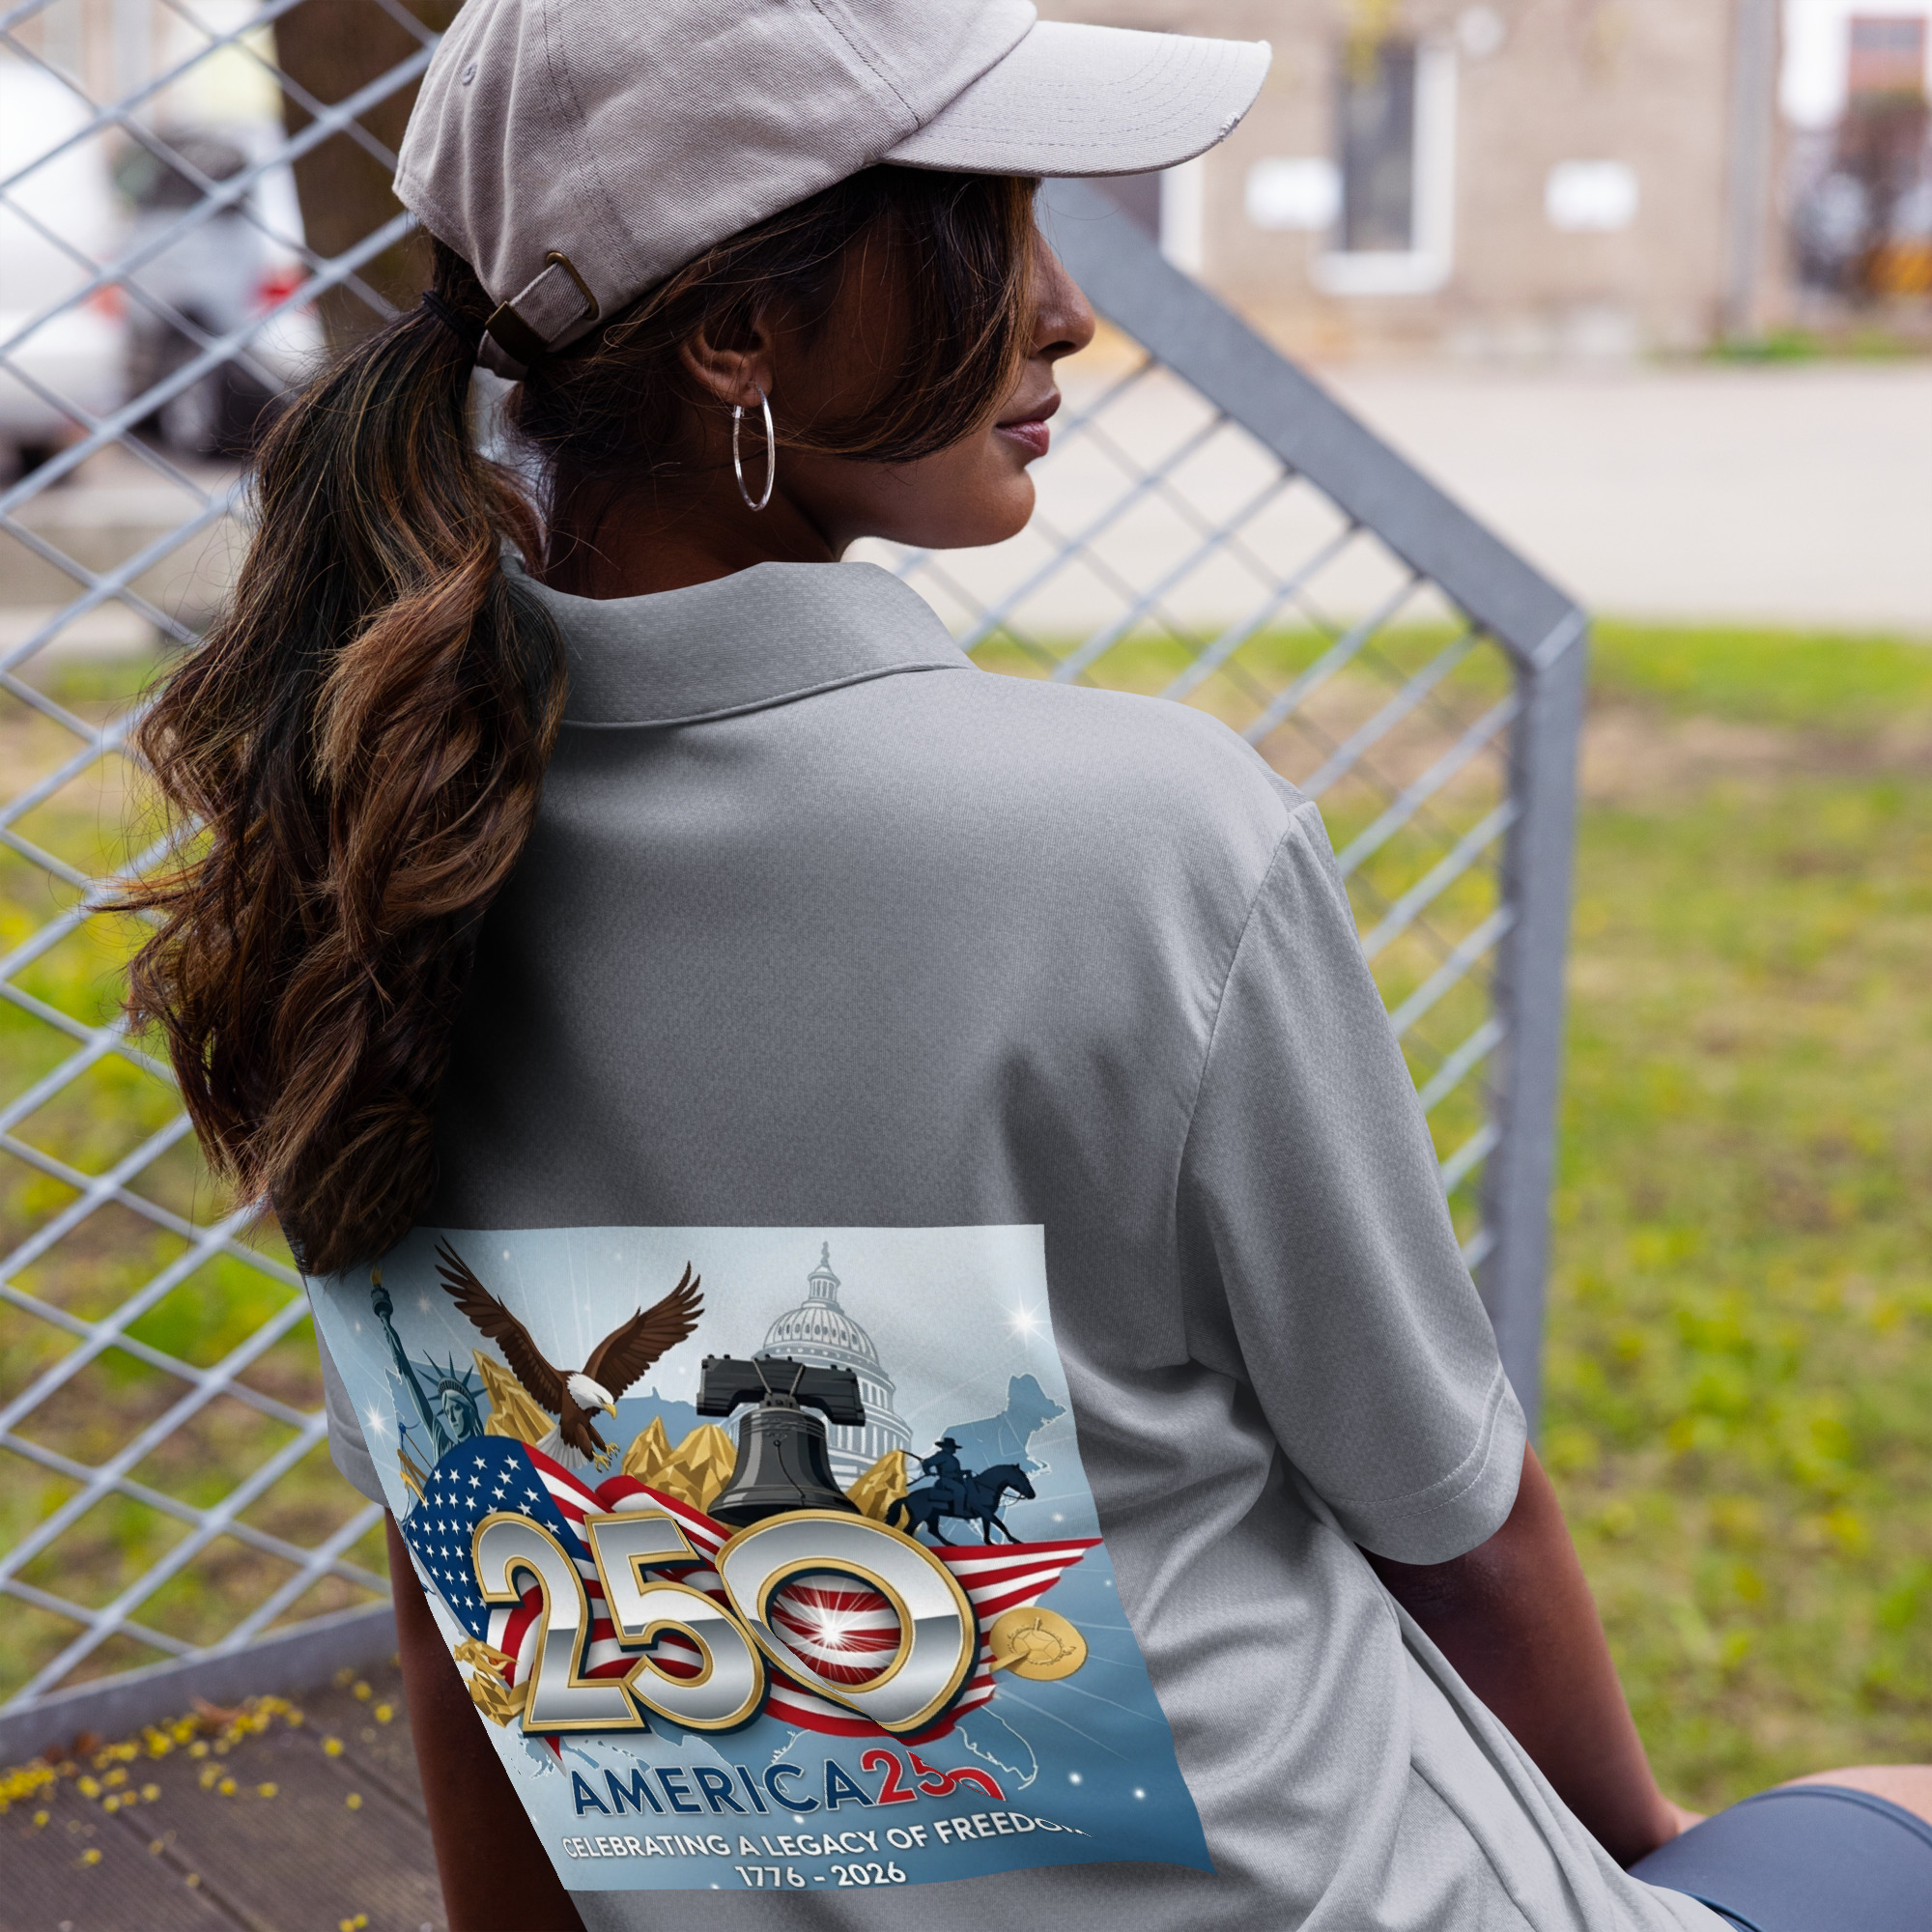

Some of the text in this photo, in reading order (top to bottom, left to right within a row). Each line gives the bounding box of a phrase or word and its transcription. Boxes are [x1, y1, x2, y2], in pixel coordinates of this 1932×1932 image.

[472, 1510, 978, 1735] 250
[562, 1834, 730, 1859] CELEBRATING
[739, 1835, 762, 1857] A
[768, 1830, 879, 1857] LEGACY
[886, 1826, 928, 1849] OF
[734, 1864, 806, 1889] 1776
[831, 1861, 907, 1887] 2026
